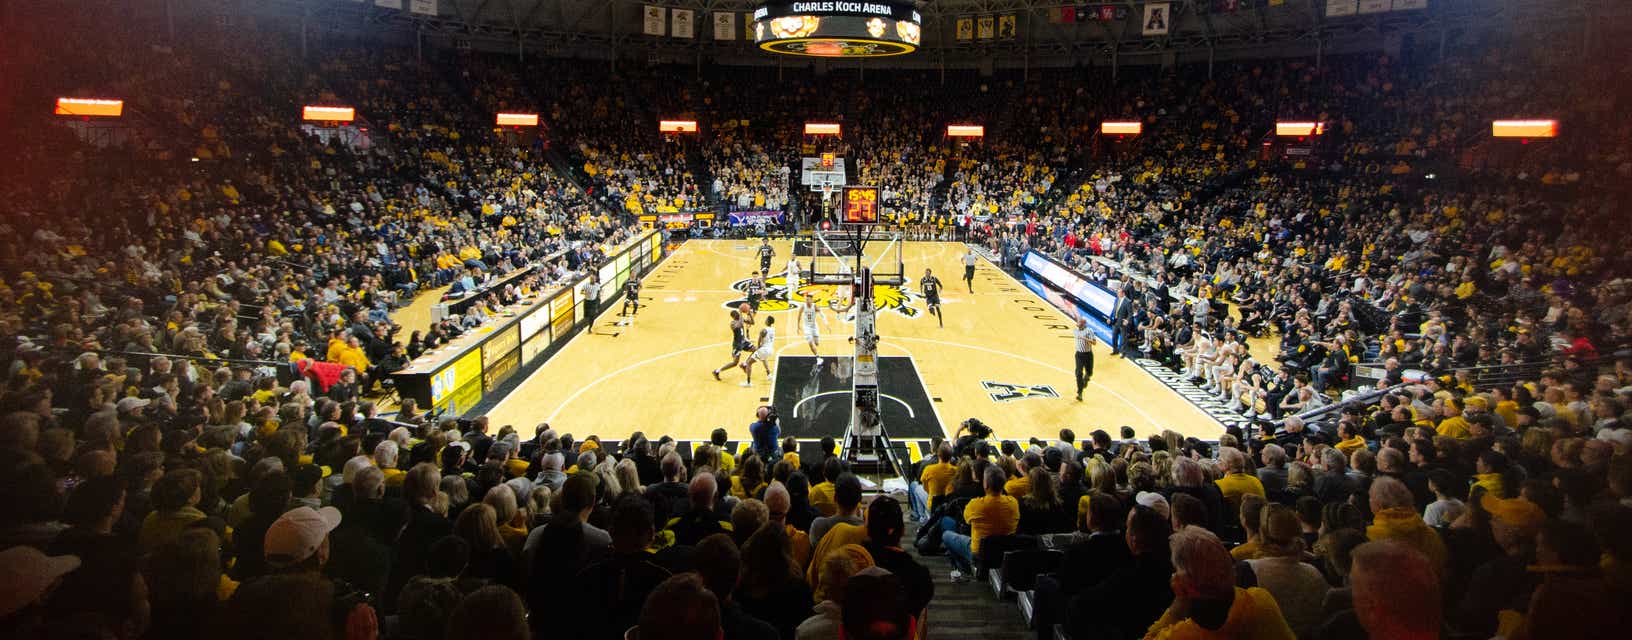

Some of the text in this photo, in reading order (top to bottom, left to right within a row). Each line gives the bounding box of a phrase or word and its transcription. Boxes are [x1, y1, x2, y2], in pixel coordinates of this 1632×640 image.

[793, 1, 892, 15] CHARLES KOCH ARENA
[848, 189, 877, 201] 15:45
[848, 201, 872, 220] 27
